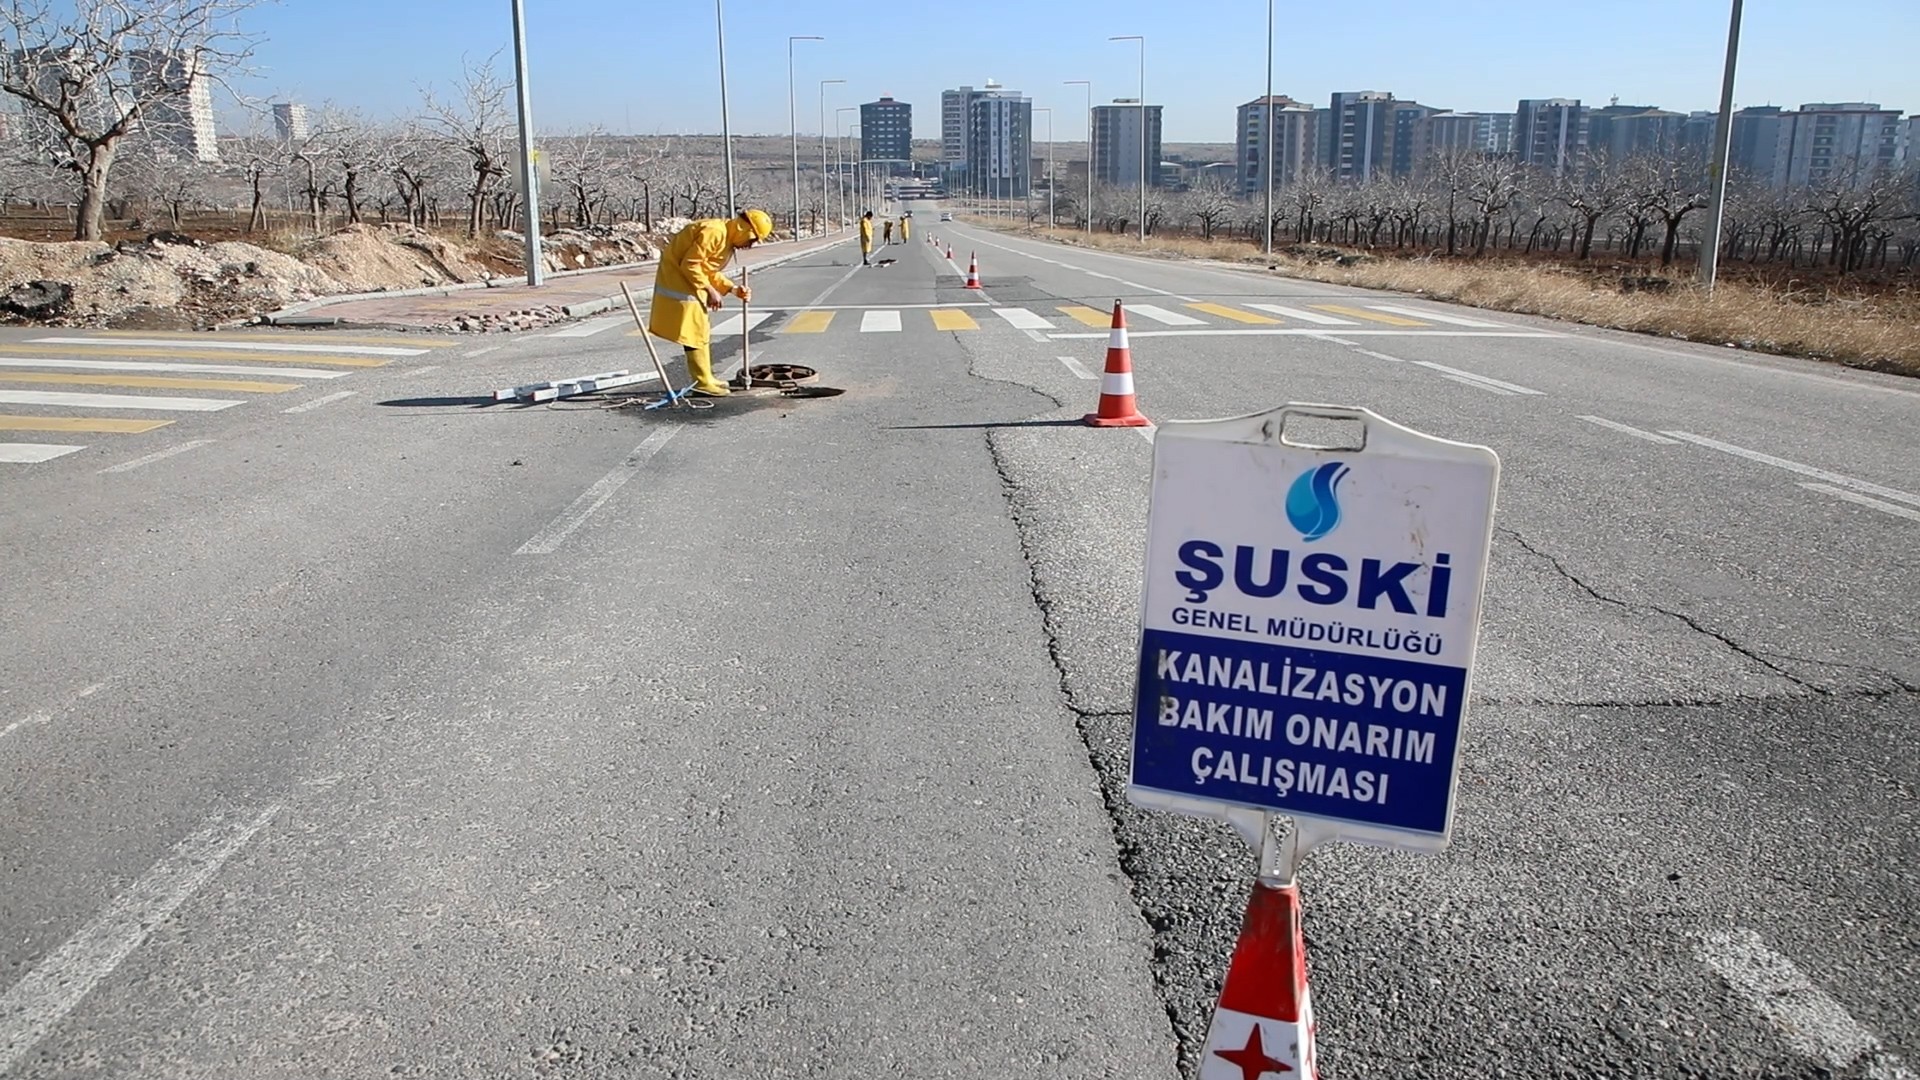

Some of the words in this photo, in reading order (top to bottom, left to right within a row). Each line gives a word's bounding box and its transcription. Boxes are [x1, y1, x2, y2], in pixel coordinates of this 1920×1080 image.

[1175, 540, 1451, 619] ŞUSKİ
[1171, 607, 1258, 634] GENEL
[1267, 618, 1443, 656] MÜDÜRLÜĞÜ
[1157, 649, 1446, 717] KANALİZASYON
[1158, 696, 1273, 740] BAKIM
[1285, 713, 1436, 764] ONARIM
[1191, 747, 1389, 805] ÇALIŞMASI
